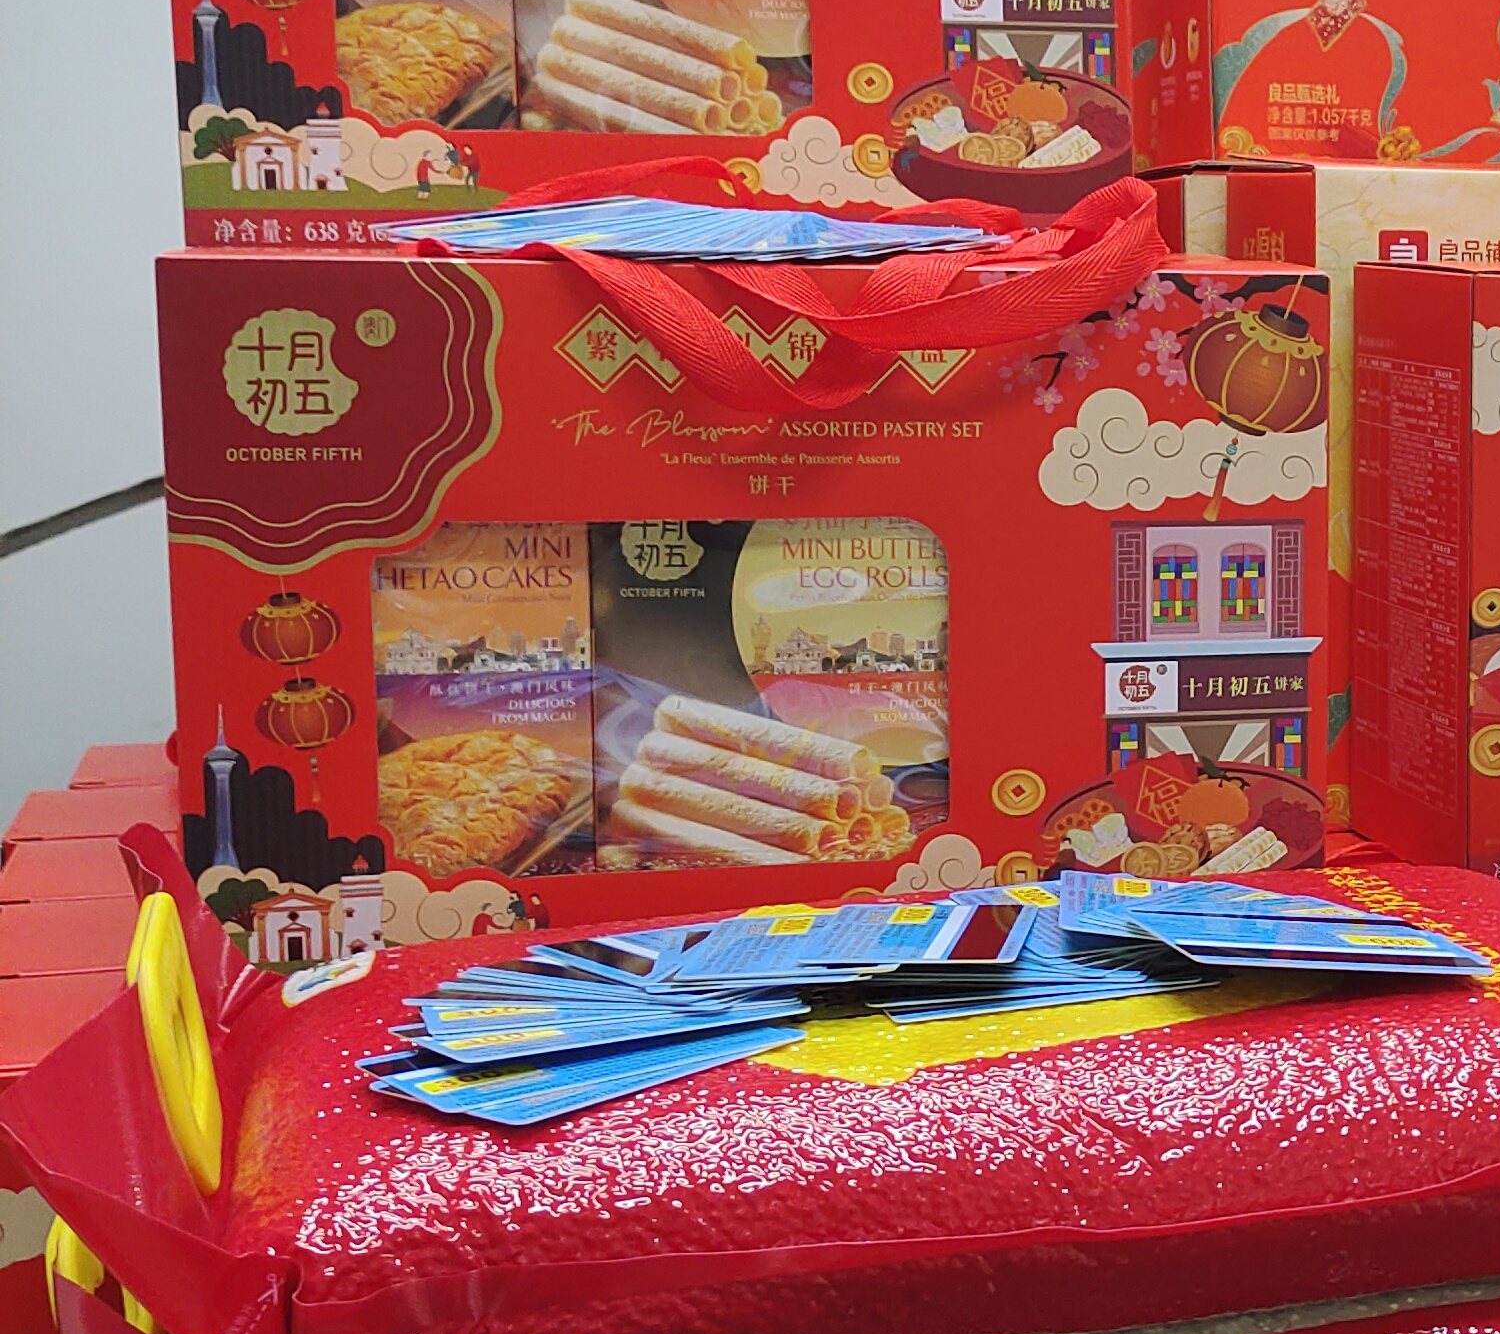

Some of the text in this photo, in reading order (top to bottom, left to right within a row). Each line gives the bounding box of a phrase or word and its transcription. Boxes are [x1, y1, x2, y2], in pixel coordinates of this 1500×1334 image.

[304, 220, 340, 243] 638
[347, 219, 366, 244] 克
[237, 326, 324, 371] 十月
[247, 378, 334, 427] 初五
[779, 420, 878, 438] ASSORTED
[882, 421, 948, 438] PASTRY
[952, 421, 984, 438] SET
[226, 447, 363, 462] OCTOBER FIFTH
[720, 452, 777, 465] Ensemble
[781, 453, 795, 465] de
[748, 474, 796, 496] 饼干
[505, 536, 572, 560] MINI
[781, 537, 842, 560] MINI
[633, 543, 689, 577] 初五
[376, 564, 574, 591] HETAO CAKES
[798, 565, 949, 589] EGG ROLLS
[619, 587, 706, 599] OCTOBER FIFTH
[1182, 675, 1305, 699] 十月初五饼家
[508, 698, 577, 710] DELICIOUS
[889, 698, 948, 710] DELICIOU
[491, 711, 576, 724] FROM MACAU
[873, 712, 908, 723] FROM
